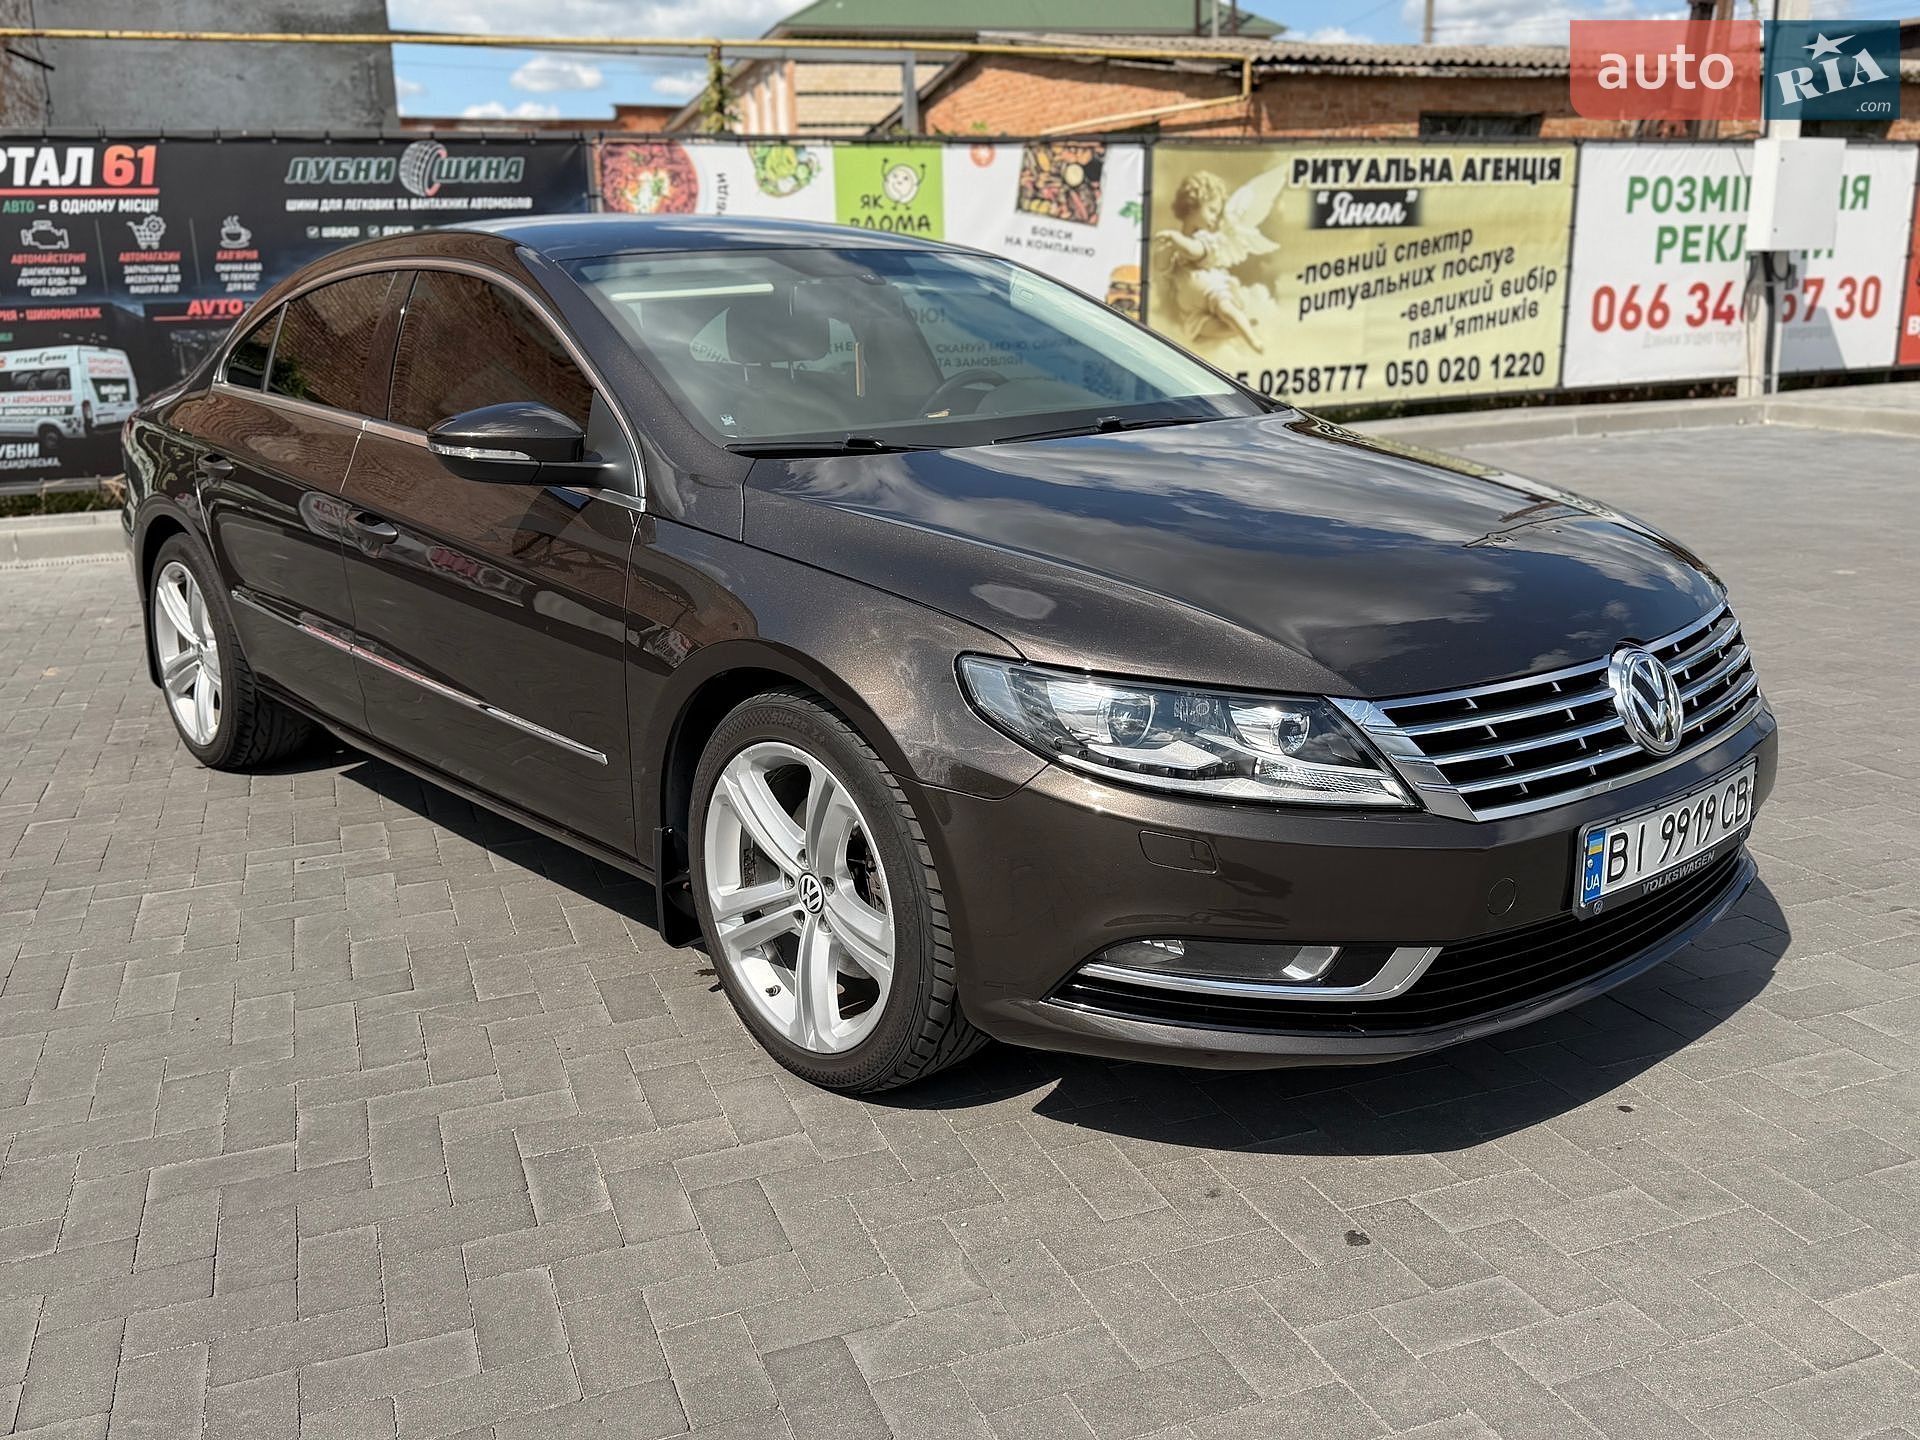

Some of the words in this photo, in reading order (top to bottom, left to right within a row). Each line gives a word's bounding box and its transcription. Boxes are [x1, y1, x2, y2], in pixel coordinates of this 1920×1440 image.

[102, 144, 157, 187] 61
[1292, 159, 1453, 184] РИТУАЛЬНА
[1461, 158, 1562, 184] АГЕНЦІЯ
[60, 198, 116, 215] ОДНОМУ
[860, 193, 883, 209] ЯК
[1004, 235, 1021, 247] НА
[1026, 238, 1096, 258] КОМПАНІЮ
[1031, 226, 1073, 241] БОКСИ
[1394, 228, 1474, 263] спектр
[1299, 264, 1436, 321] ритуальних
[1442, 248, 1516, 280] послуг
[1501, 265, 1558, 294] вибір
[1591, 283, 1671, 333] 066
[1835, 275, 1882, 320] 30
[1260, 364, 1368, 396] 0258777
[1386, 359, 1429, 387] 050
[1438, 356, 1481, 383] 020
[1491, 351, 1546, 379] 1220
[1657, 795, 1716, 864] 9919
[1585, 876, 1600, 891] UA
[1641, 851, 1715, 894] VOLKSWAGEN
